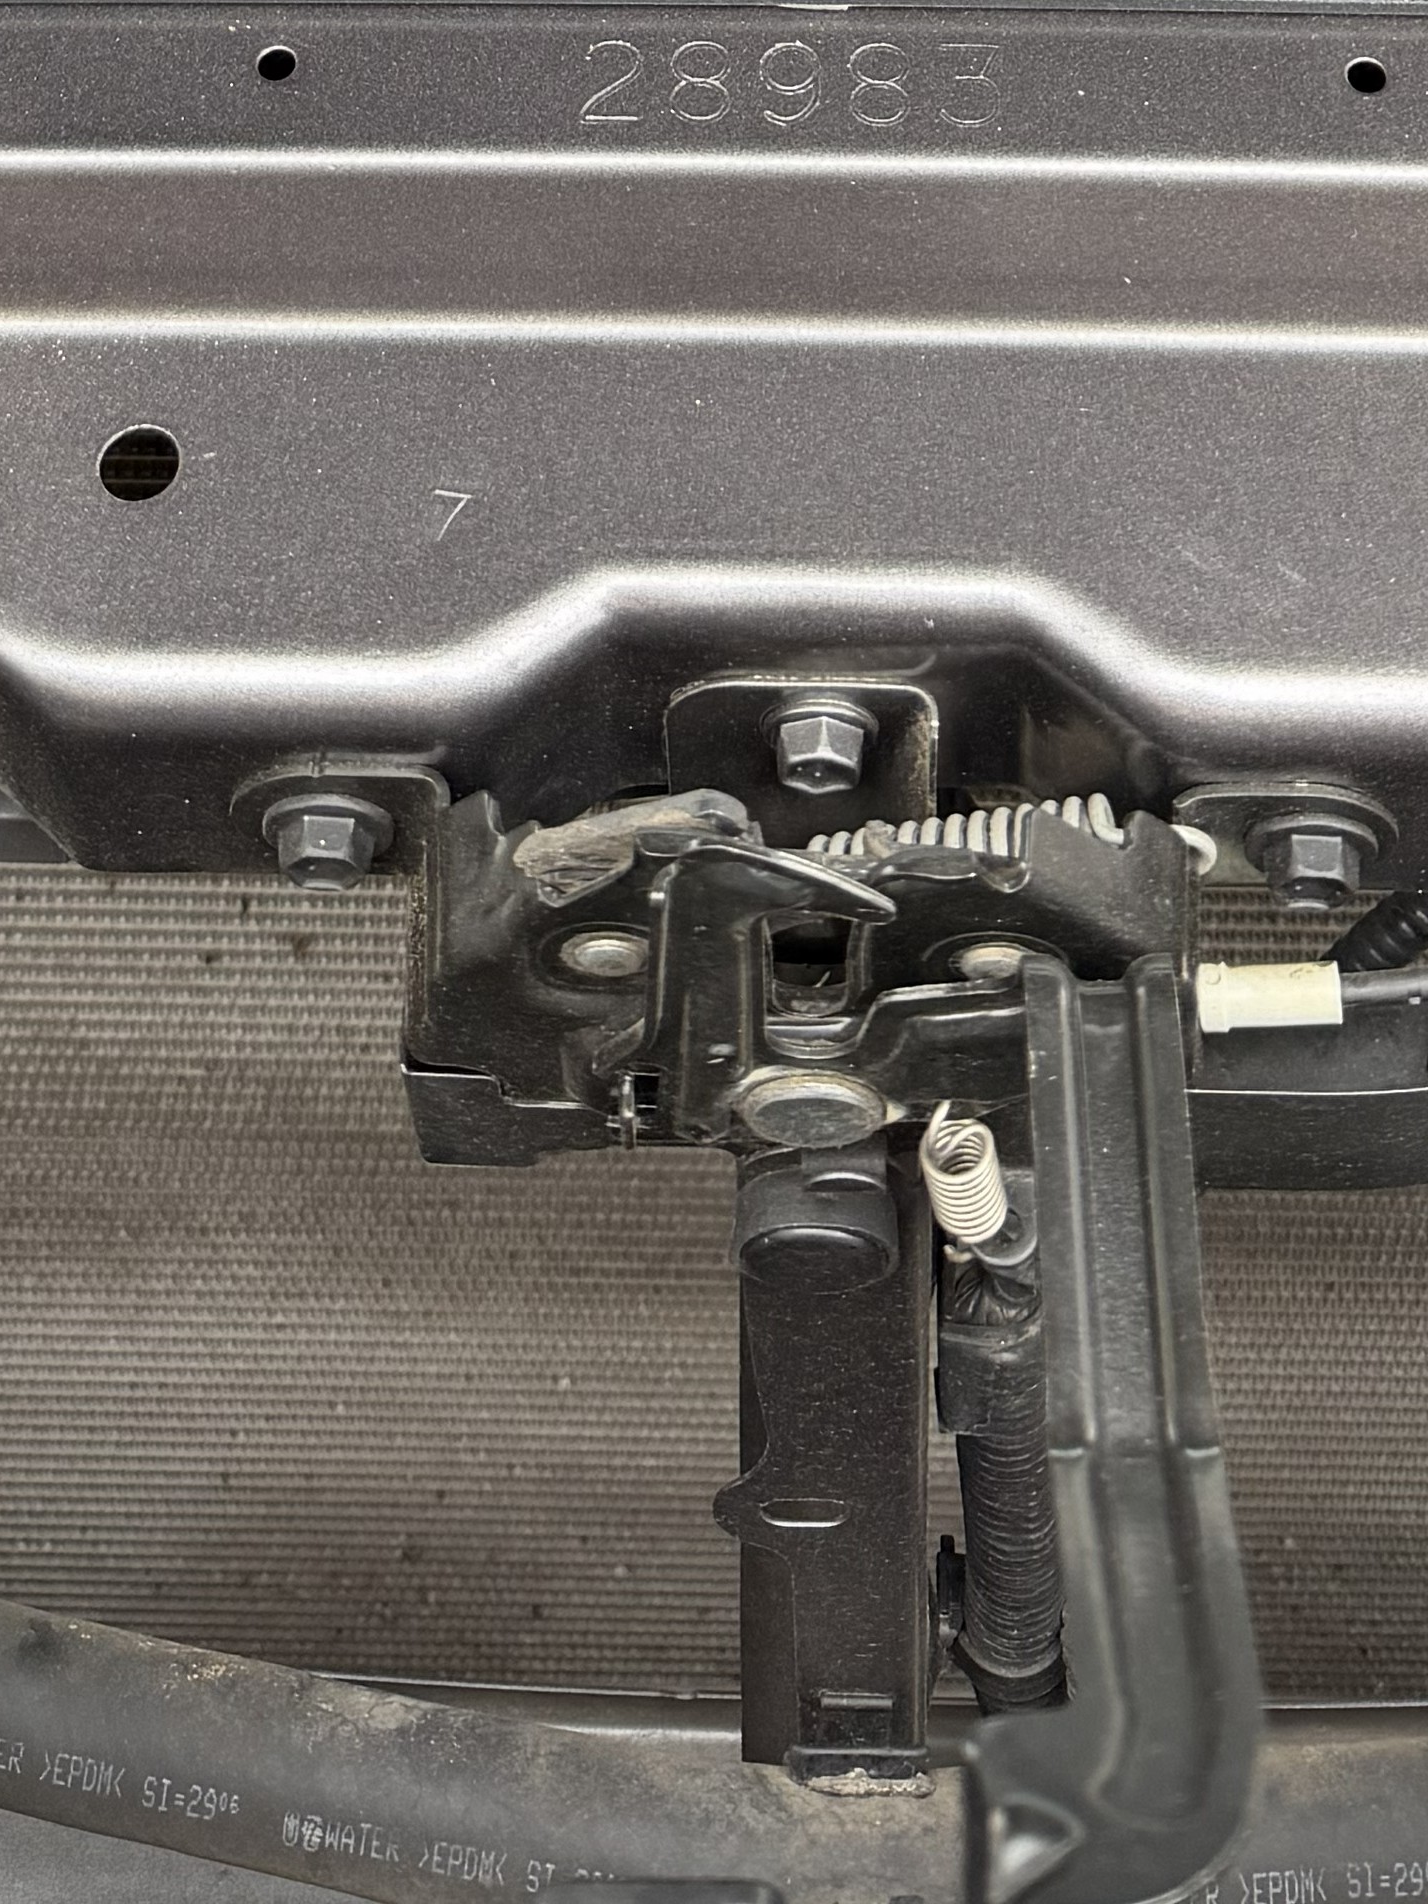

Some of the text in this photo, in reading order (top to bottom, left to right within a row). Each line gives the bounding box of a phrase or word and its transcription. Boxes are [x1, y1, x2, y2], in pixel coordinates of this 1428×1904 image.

[578, 39, 1001, 126] 28983
[434, 488, 474, 542] 7
[323, 1820, 400, 1863] WATER
